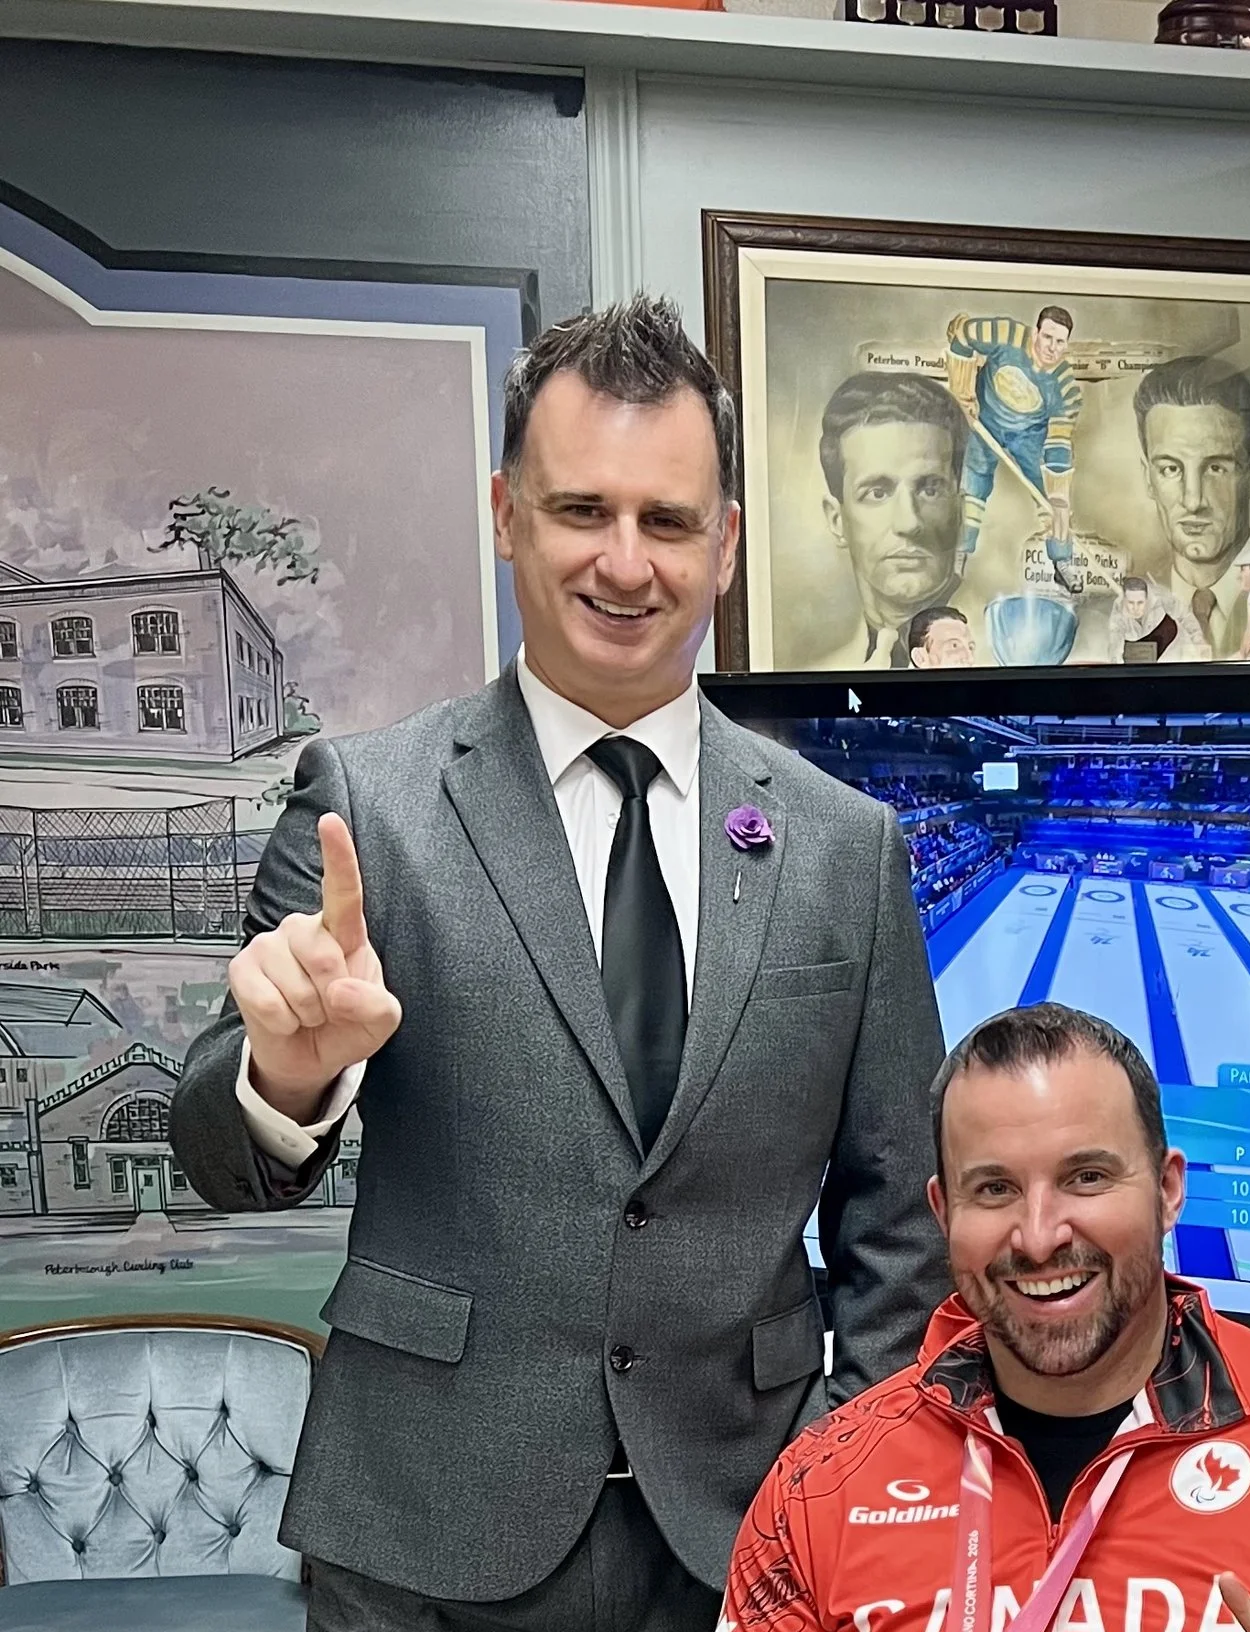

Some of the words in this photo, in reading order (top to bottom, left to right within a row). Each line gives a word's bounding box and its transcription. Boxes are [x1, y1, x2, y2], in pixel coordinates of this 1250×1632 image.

[867, 352, 909, 367] Peterboro
[1235, 1146, 1245, 1161] P
[1231, 1180, 1249, 1197] 10
[1231, 1208, 1249, 1225] 10
[45, 1263, 121, 1277] Peterborough
[123, 1258, 166, 1275] Curling
[170, 1258, 194, 1270] Club
[848, 1503, 960, 1525] Goldline
[967, 1529, 979, 1558] 2026
[964, 1558, 979, 1615] CORTINA
